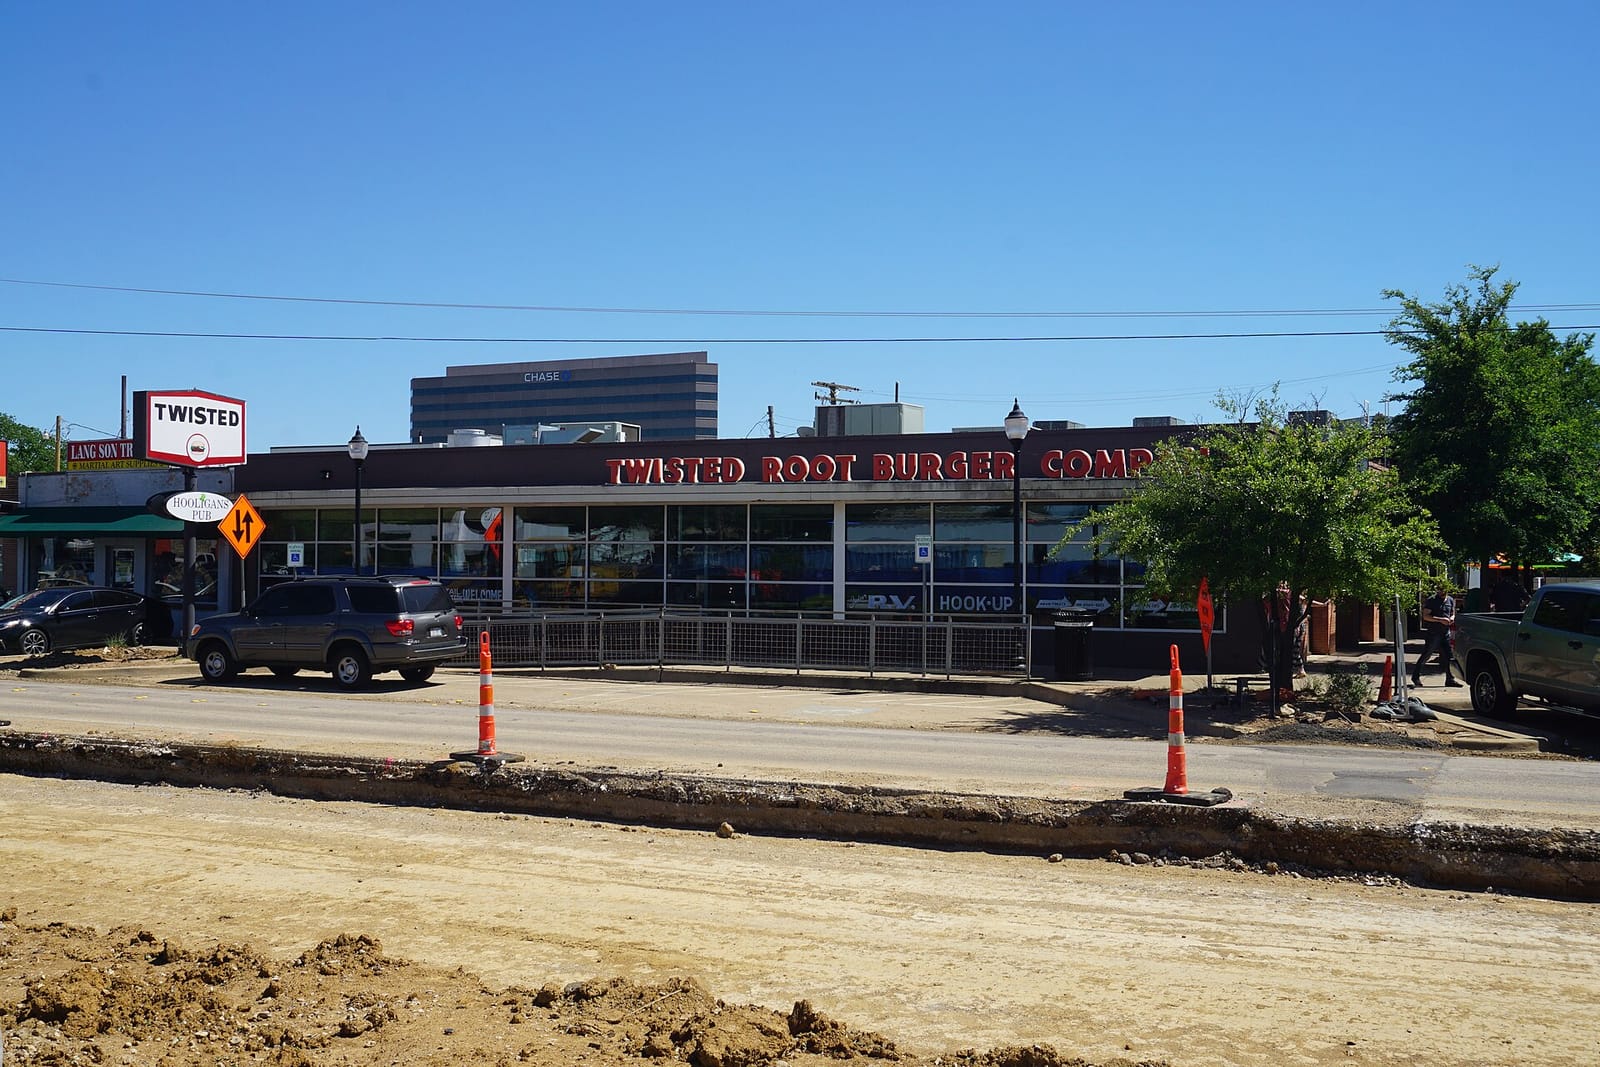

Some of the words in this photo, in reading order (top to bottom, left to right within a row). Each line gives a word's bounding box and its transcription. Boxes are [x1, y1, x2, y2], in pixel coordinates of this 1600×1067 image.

[524, 371, 560, 382] CHASE
[154, 403, 240, 427] TWISTED
[71, 444, 97, 460] LANG
[98, 442, 118, 459] SON
[119, 442, 134, 458] TR
[79, 461, 109, 470] MARTIAL
[111, 460, 125, 469] ART
[605, 456, 746, 484] TWISTED
[761, 454, 857, 483] ROOT
[872, 451, 1015, 481] BURGER
[1040, 447, 1210, 480] COMP
[173, 497, 230, 509] HOOLIGANS
[192, 510, 212, 520] PUB
[463, 588, 502, 600] WELCOME
